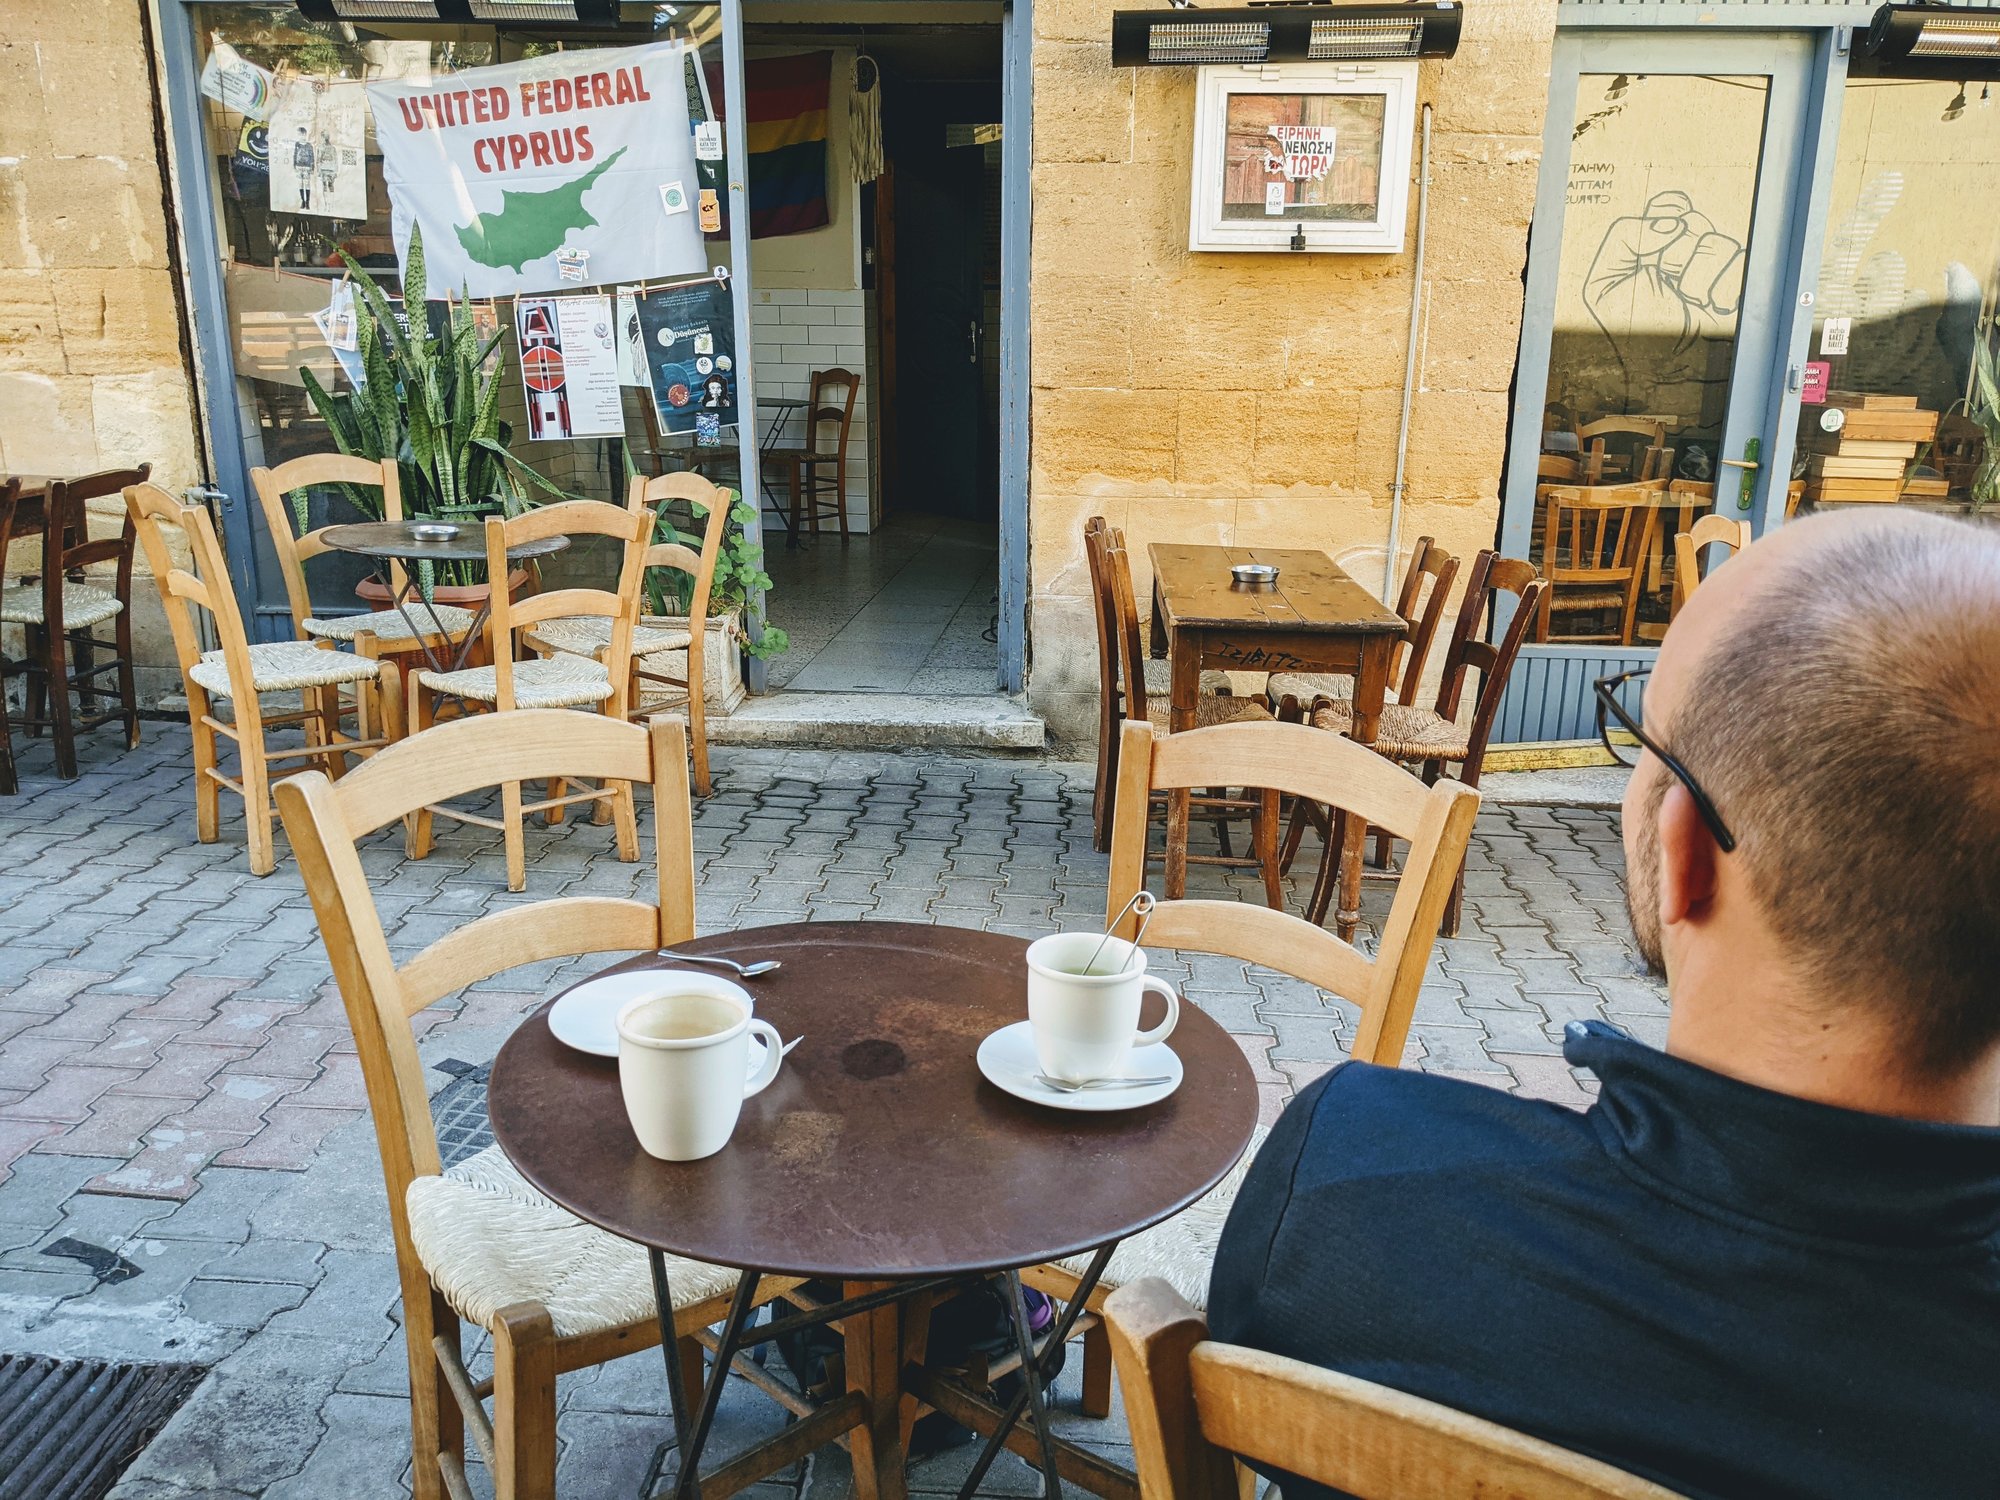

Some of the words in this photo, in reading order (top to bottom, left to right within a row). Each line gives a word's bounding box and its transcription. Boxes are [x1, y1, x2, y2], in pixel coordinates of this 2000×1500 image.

[398, 86, 510, 132] UNITED
[520, 66, 651, 117] FEDERAL
[474, 125, 594, 173] CYPRUS
[1277, 127, 1321, 141] ΕΙΡΗΝΗ
[1285, 141, 1333, 154] ΝΕΝΩΣΗ
